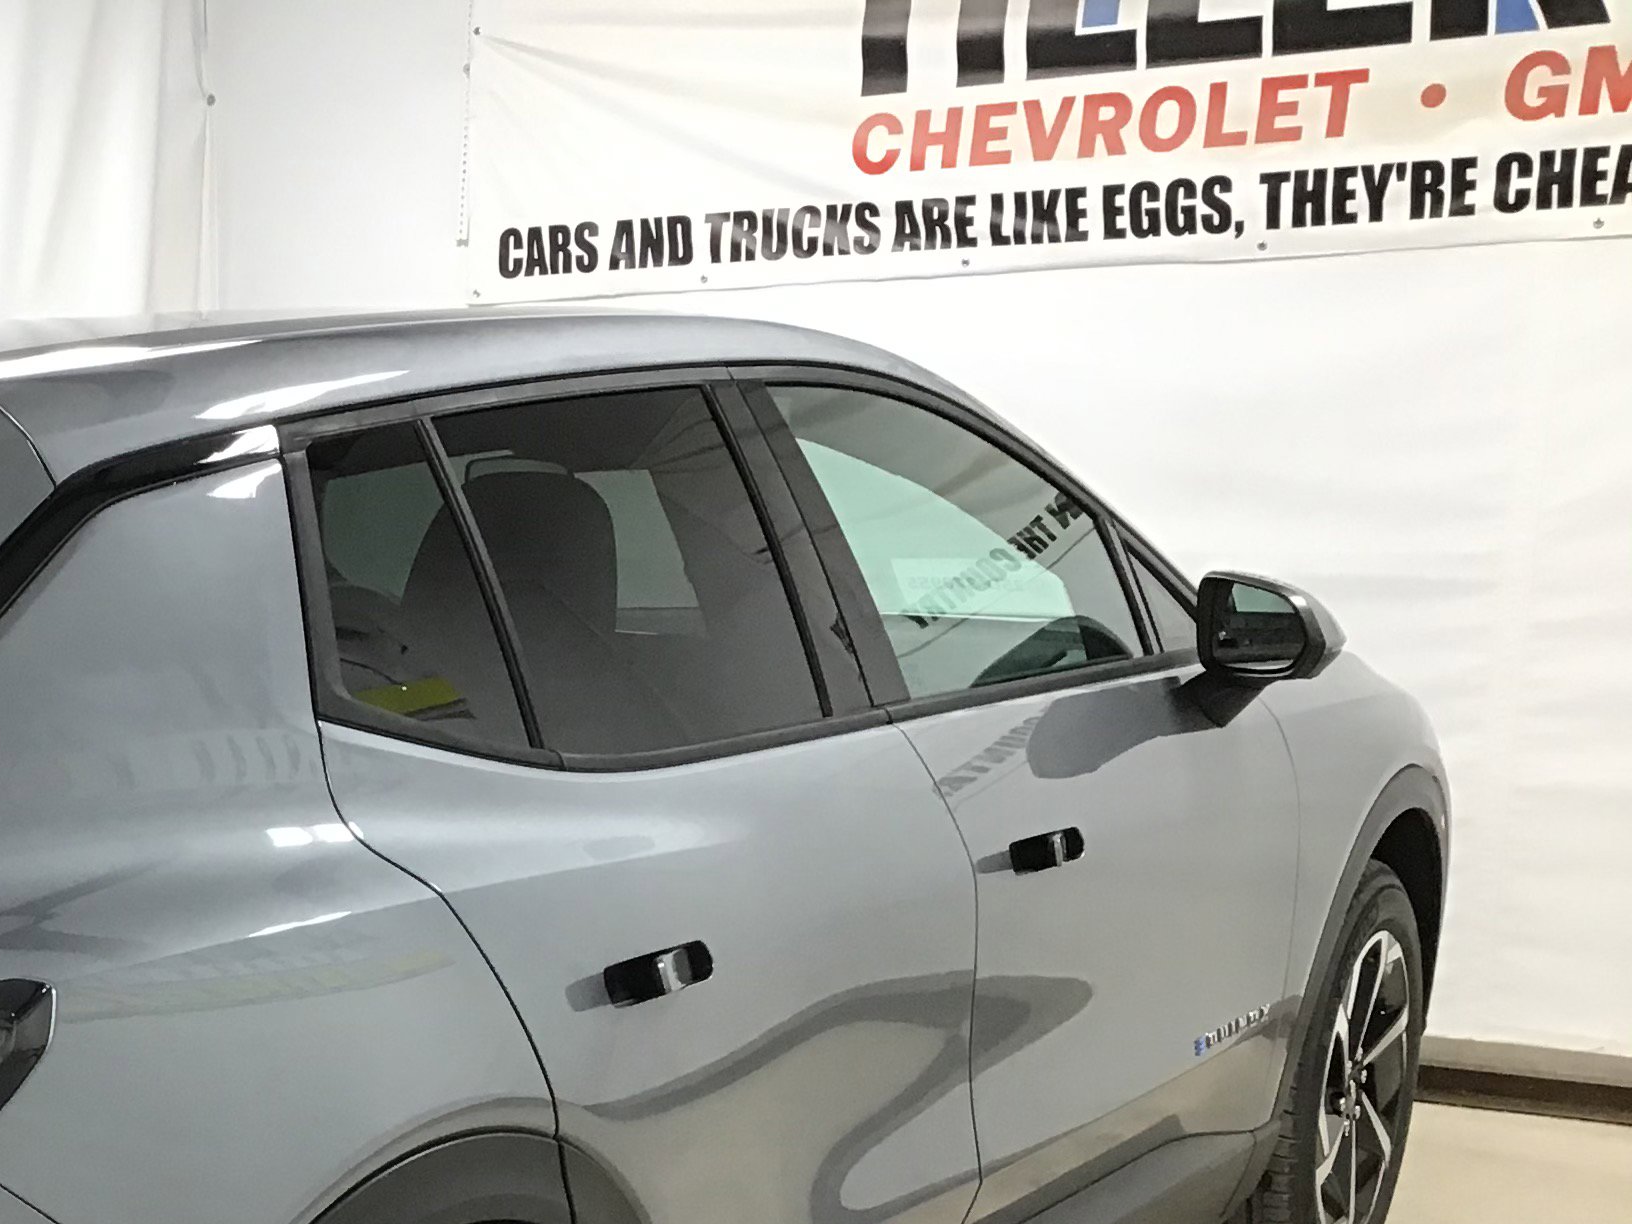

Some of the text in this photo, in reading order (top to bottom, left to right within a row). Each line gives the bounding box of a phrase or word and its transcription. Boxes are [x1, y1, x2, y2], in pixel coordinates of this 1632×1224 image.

[852, 68, 1370, 175] CHEVROLET
[498, 221, 598, 280] CARS
[608, 214, 694, 271] AND
[704, 202, 881, 265] TRUCKS
[891, 194, 978, 253] ARE
[989, 186, 1089, 247] LIKE
[1102, 175, 1246, 243] EGGS,
[1259, 156, 1479, 231] THEY'RE
